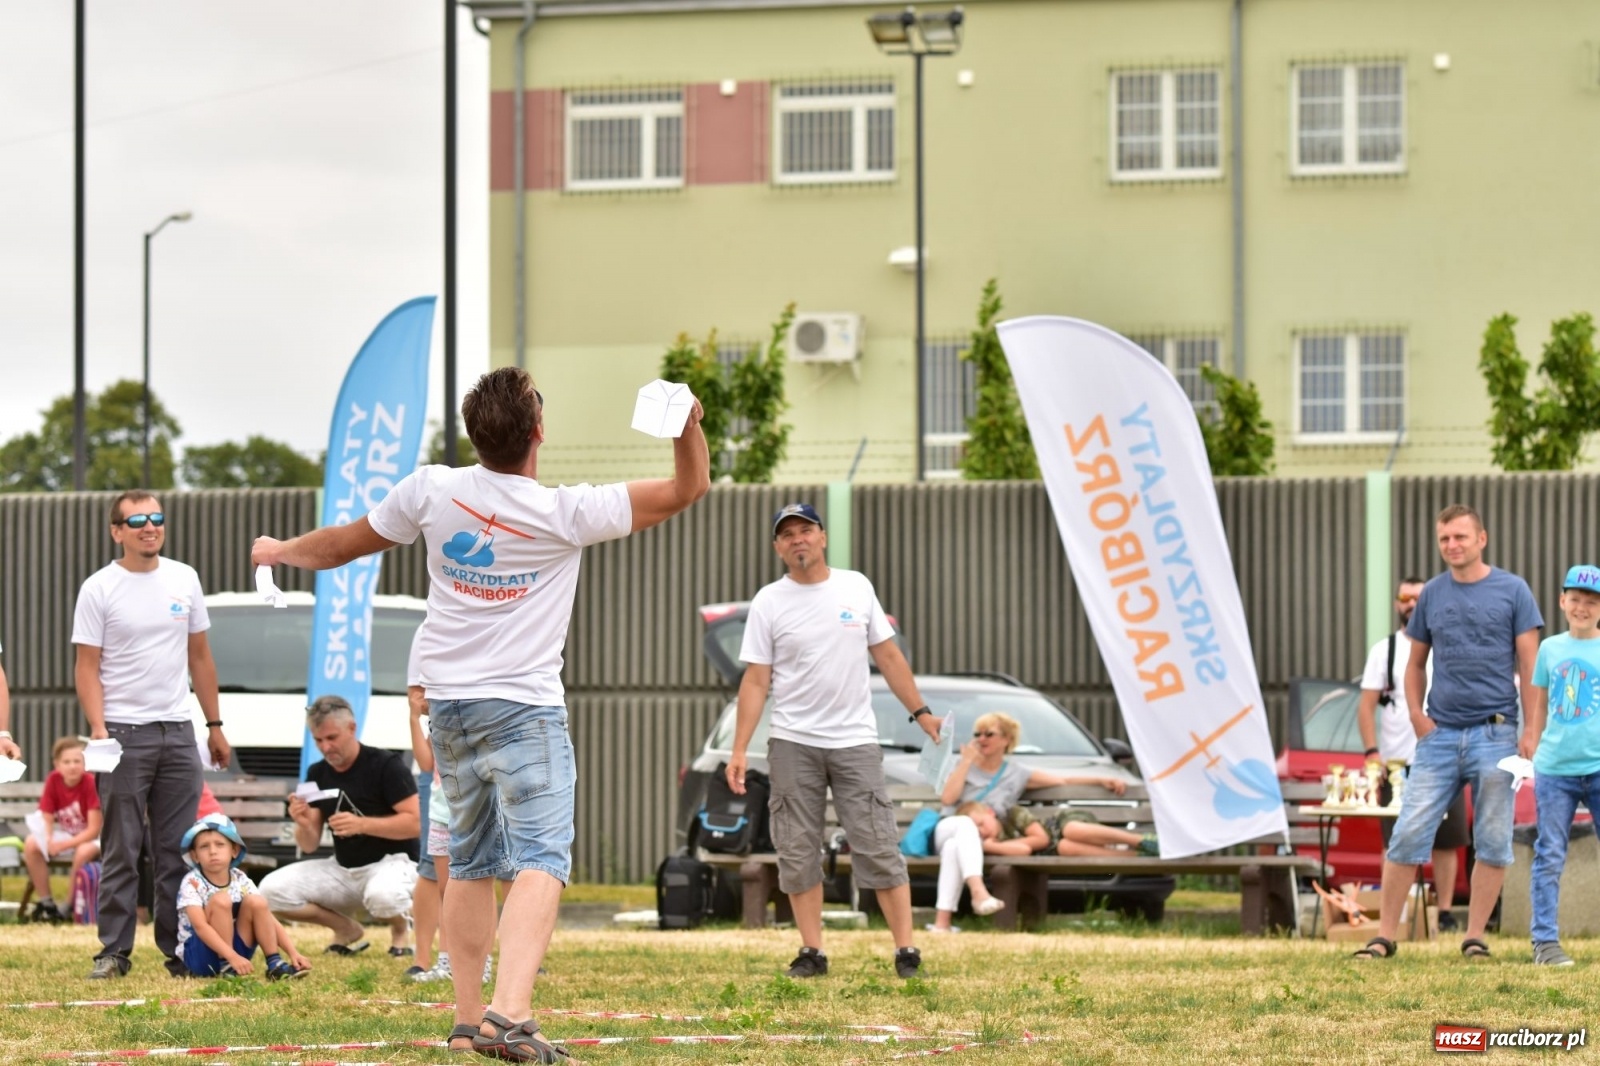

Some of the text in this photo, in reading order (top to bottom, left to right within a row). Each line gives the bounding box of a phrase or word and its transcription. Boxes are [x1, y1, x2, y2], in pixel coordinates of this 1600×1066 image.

[441, 564, 539, 587] SKRZYDLATY
[1577, 572, 1599, 585] NY
[453, 581, 529, 601] RACIBÓRZ
